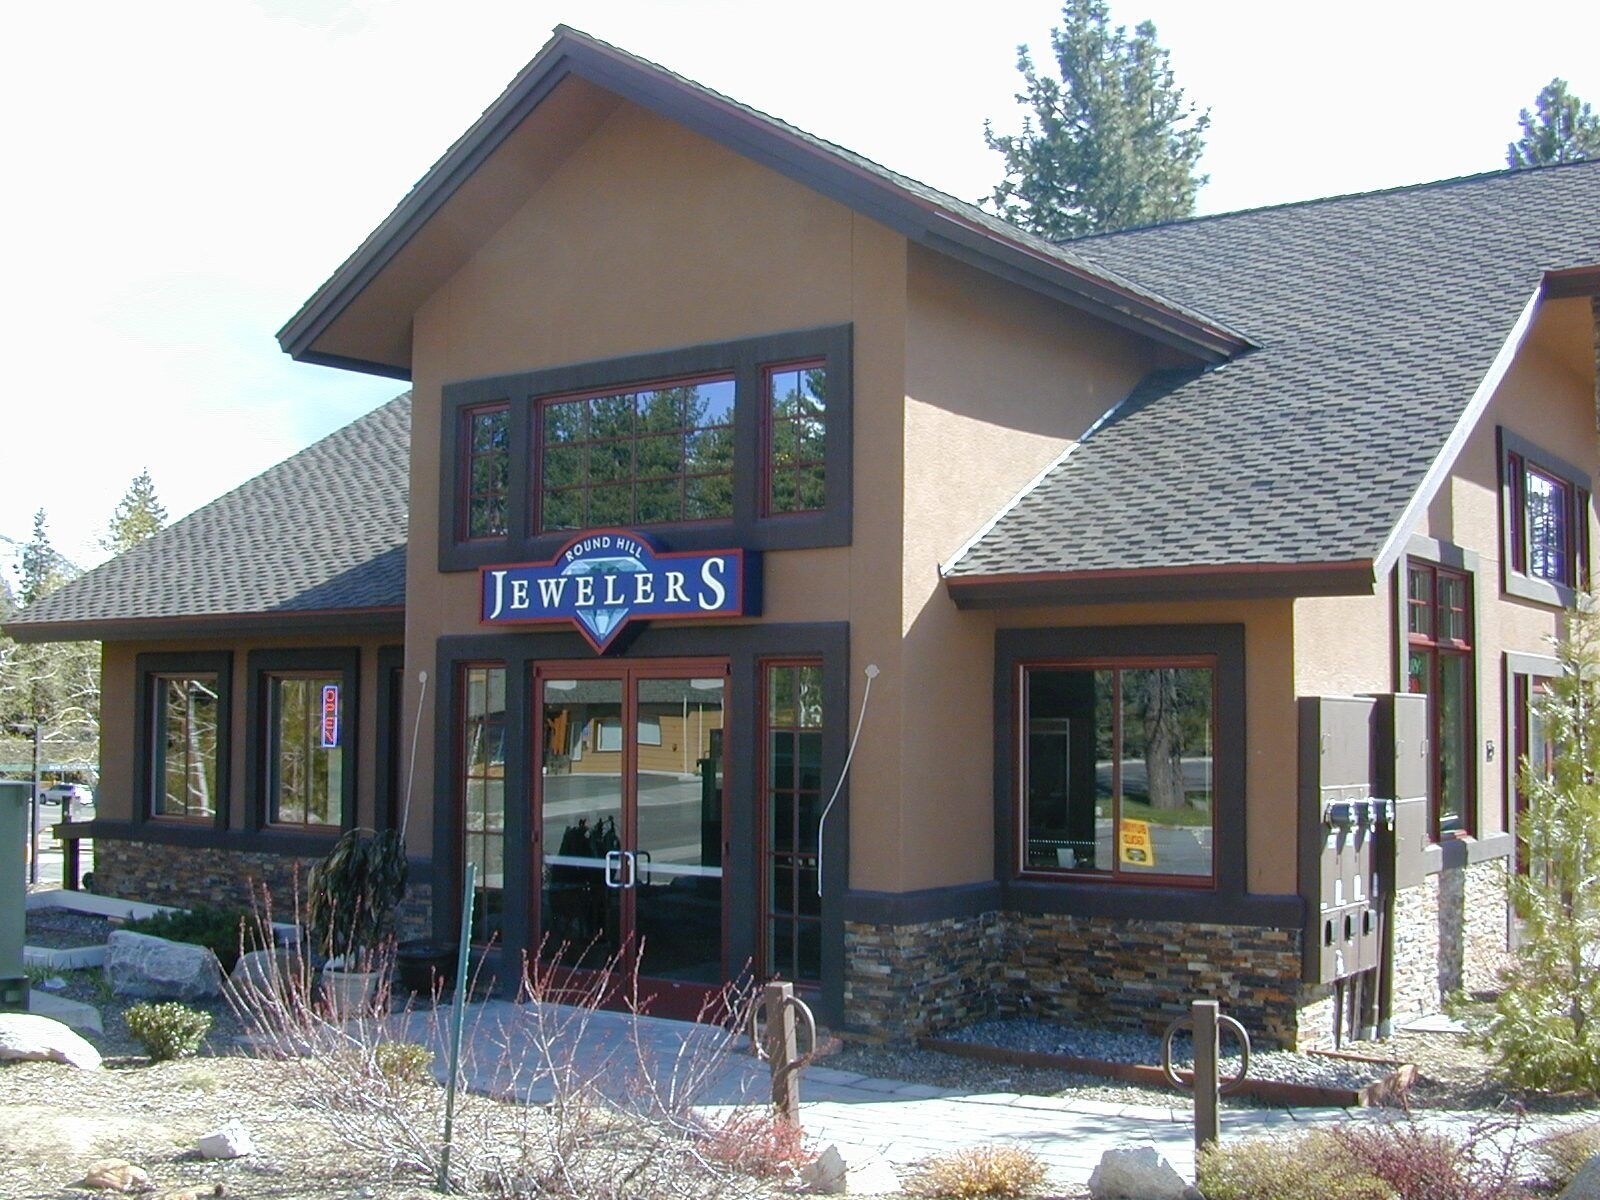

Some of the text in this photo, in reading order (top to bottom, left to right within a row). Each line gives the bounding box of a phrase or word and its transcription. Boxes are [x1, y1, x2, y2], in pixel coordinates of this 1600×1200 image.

[565, 536, 642, 562] ROUND HILL
[489, 557, 726, 620] JEWELERS
